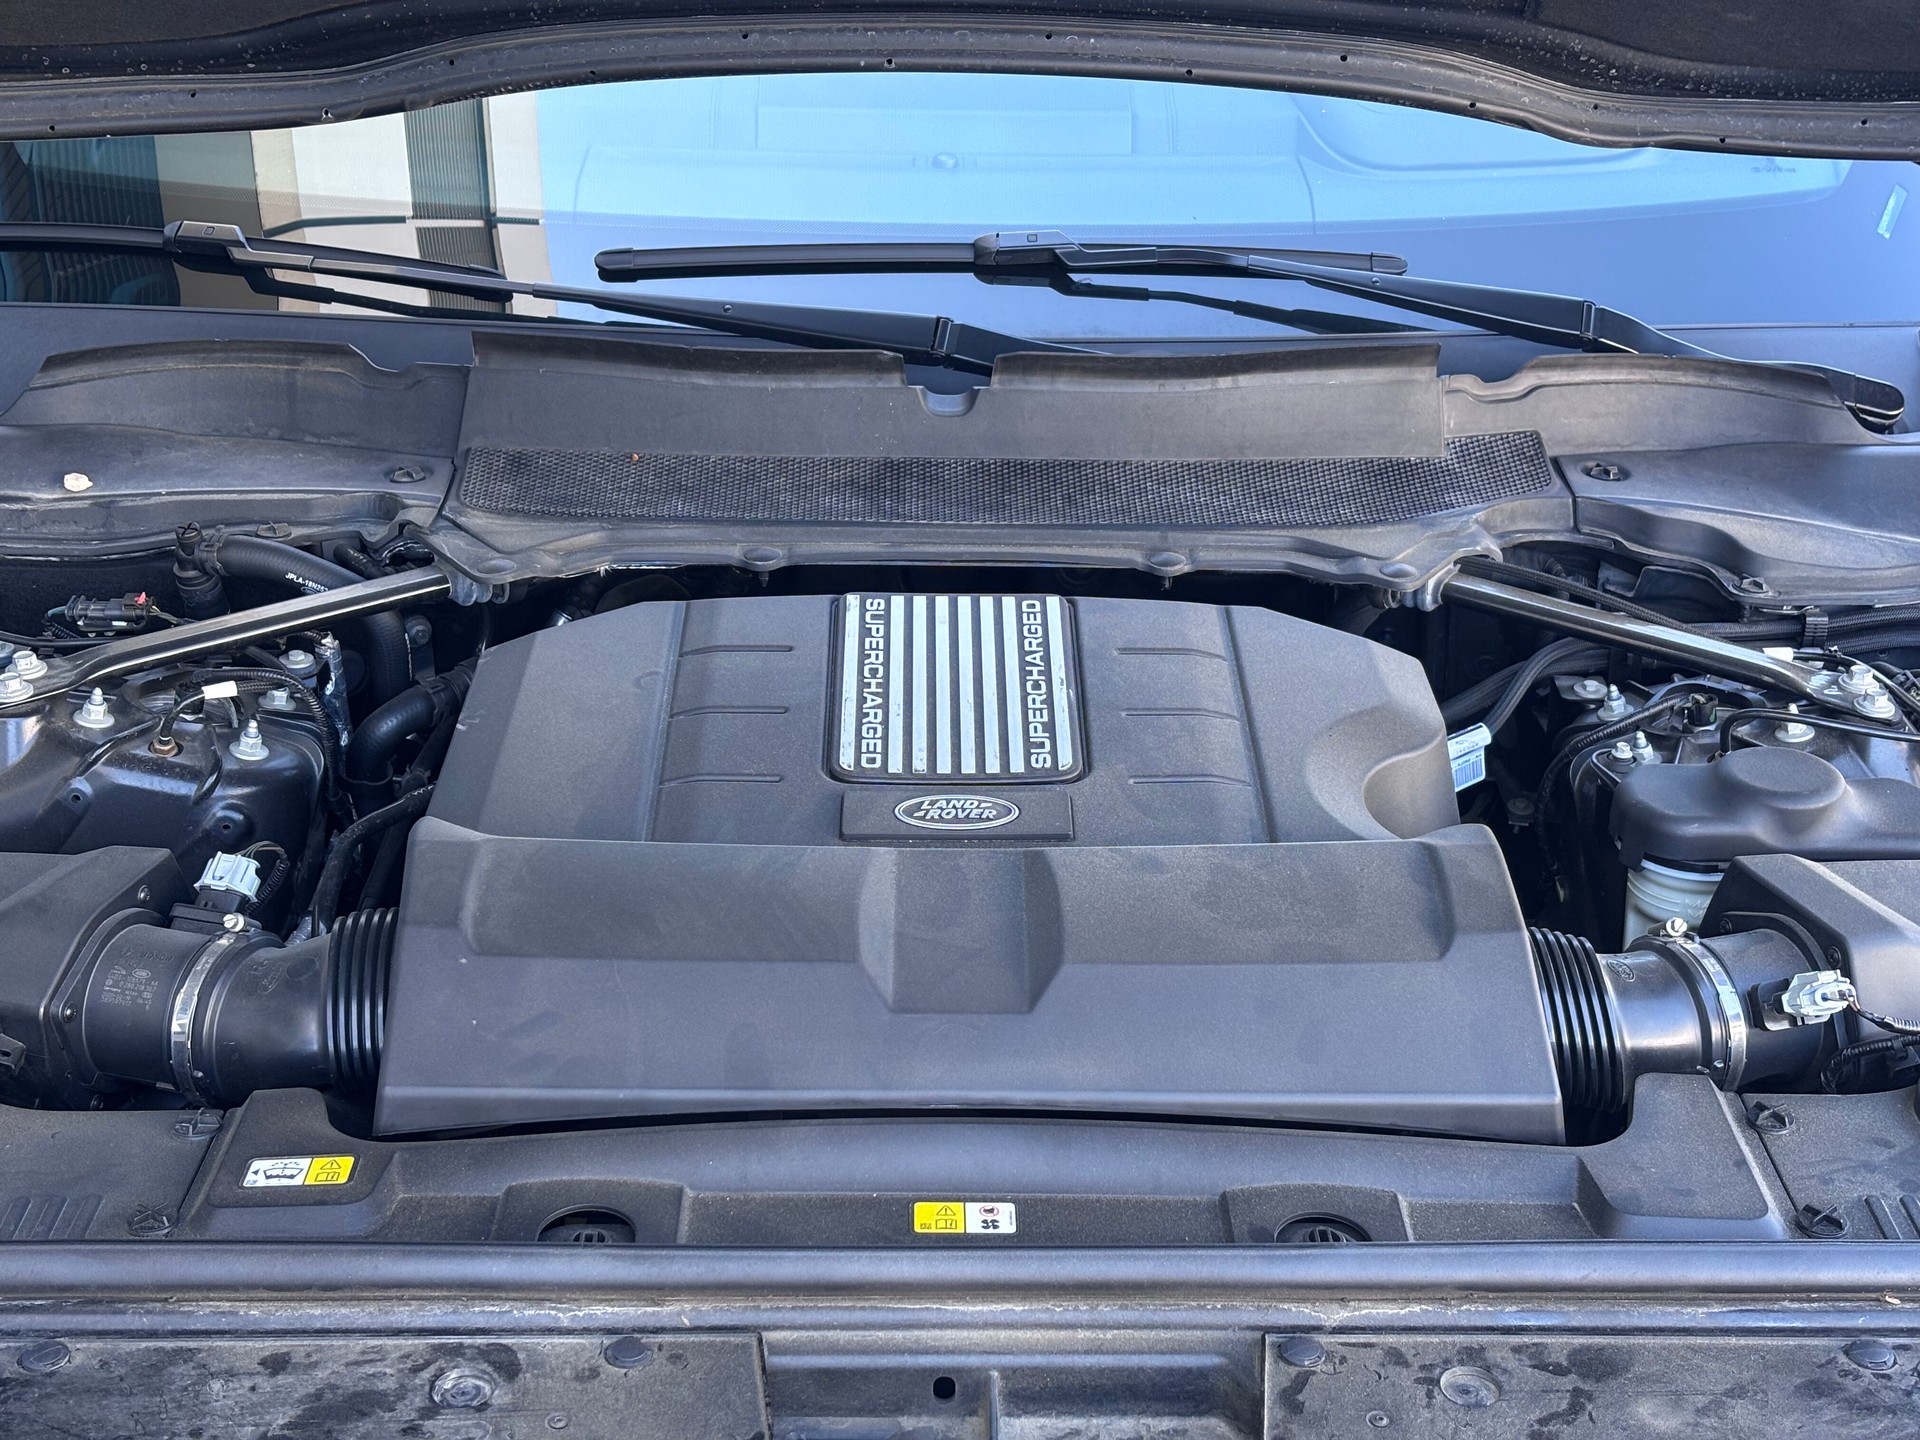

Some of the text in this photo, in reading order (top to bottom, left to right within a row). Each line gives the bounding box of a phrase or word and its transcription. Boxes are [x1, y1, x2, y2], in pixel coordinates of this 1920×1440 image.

[860, 598, 885, 769] SUPERCHARGED
[1021, 600, 1051, 769] SUPERCHARGED
[920, 799, 979, 810] LAND
[925, 808, 997, 820] ROVER
